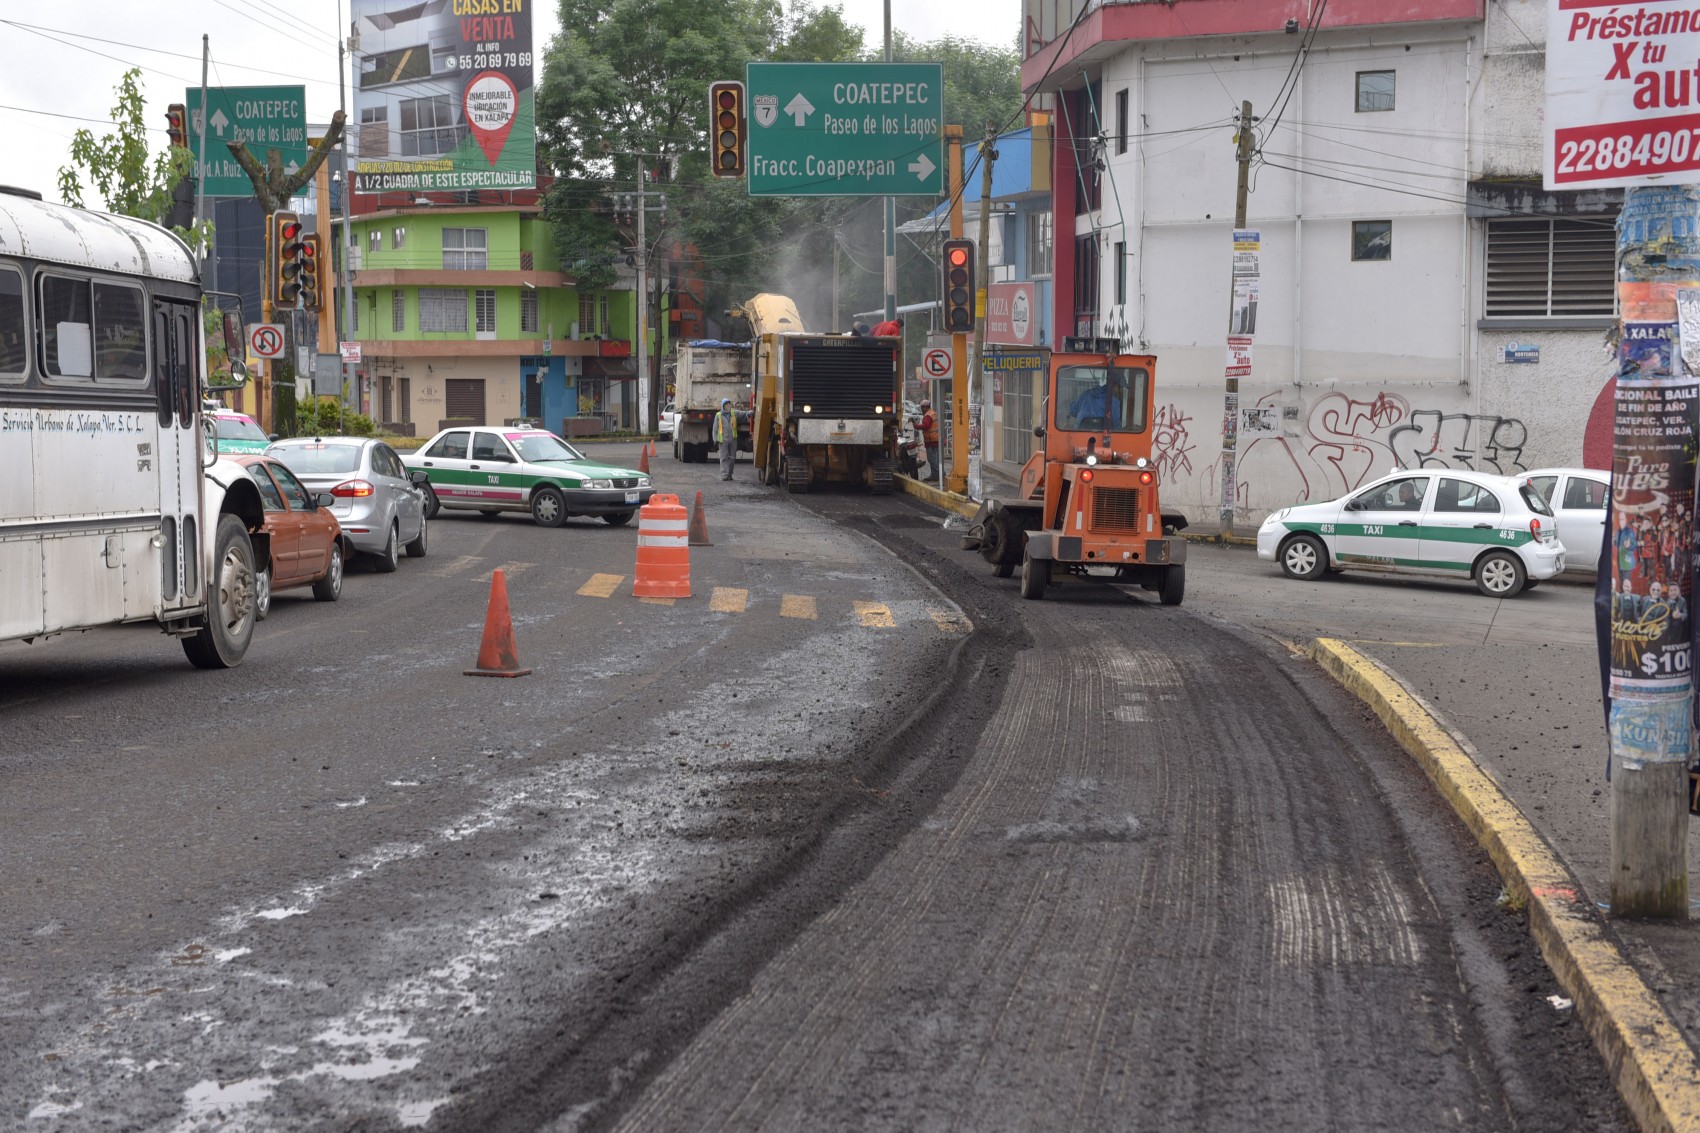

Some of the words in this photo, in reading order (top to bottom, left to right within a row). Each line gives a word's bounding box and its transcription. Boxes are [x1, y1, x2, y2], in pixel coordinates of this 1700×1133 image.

[504, 0, 522, 13] EN
[461, 16, 515, 42] VENTA
[476, 43, 485, 52] AL
[485, 42, 500, 52] INFO
[1642, 41, 1667, 64] tu
[459, 55, 472, 69] 55
[474, 54, 487, 69] 20
[490, 54, 502, 68] 69
[504, 53, 517, 68] 79
[518, 52, 532, 67] 69
[469, 91, 512, 101] INMEJORABLE
[833, 83, 929, 105] COATEPEC
[236, 100, 299, 120] COATEPEC
[474, 101, 508, 112] UBICACIÓN
[762, 107, 771, 119] 7
[474, 113, 484, 123] EN
[485, 112, 510, 123] XALAPA
[824, 114, 858, 135] Paseo
[863, 114, 877, 134] de
[882, 114, 899, 134] los
[904, 114, 937, 141] Lagos
[233, 124, 255, 142] Paseo
[257, 124, 266, 143] de
[268, 124, 280, 142] los
[282, 124, 303, 146] Lagos
[753, 155, 802, 177] Fracc.
[806, 154, 896, 181] Coapexpan
[355, 175, 362, 189] A
[364, 175, 381, 189] 1/2
[383, 174, 420, 189] CUADRA
[422, 173, 434, 188] DE
[436, 173, 459, 187] ESTE
[461, 170, 532, 186] ESPECTACULAR
[989, 297, 1009, 316] PIZZA
[1665, 387, 1698, 400] BAILE
[1628, 403, 1645, 412] FIN
[1647, 403, 1662, 413] DE
[1664, 401, 1687, 412] AÑO
[2, 412, 34, 432] Servicio
[66, 414, 74, 431] de
[1662, 416, 1685, 425] VER.
[1633, 427, 1663, 436] CRUZ
[1666, 426, 1692, 436] ROJA
[1625, 455, 1670, 473] Puro
[487, 474, 500, 485] TAXI
[1320, 523, 1335, 534] 4636
[1363, 525, 1384, 536] TAXI
[1499, 529, 1515, 541] 4636
